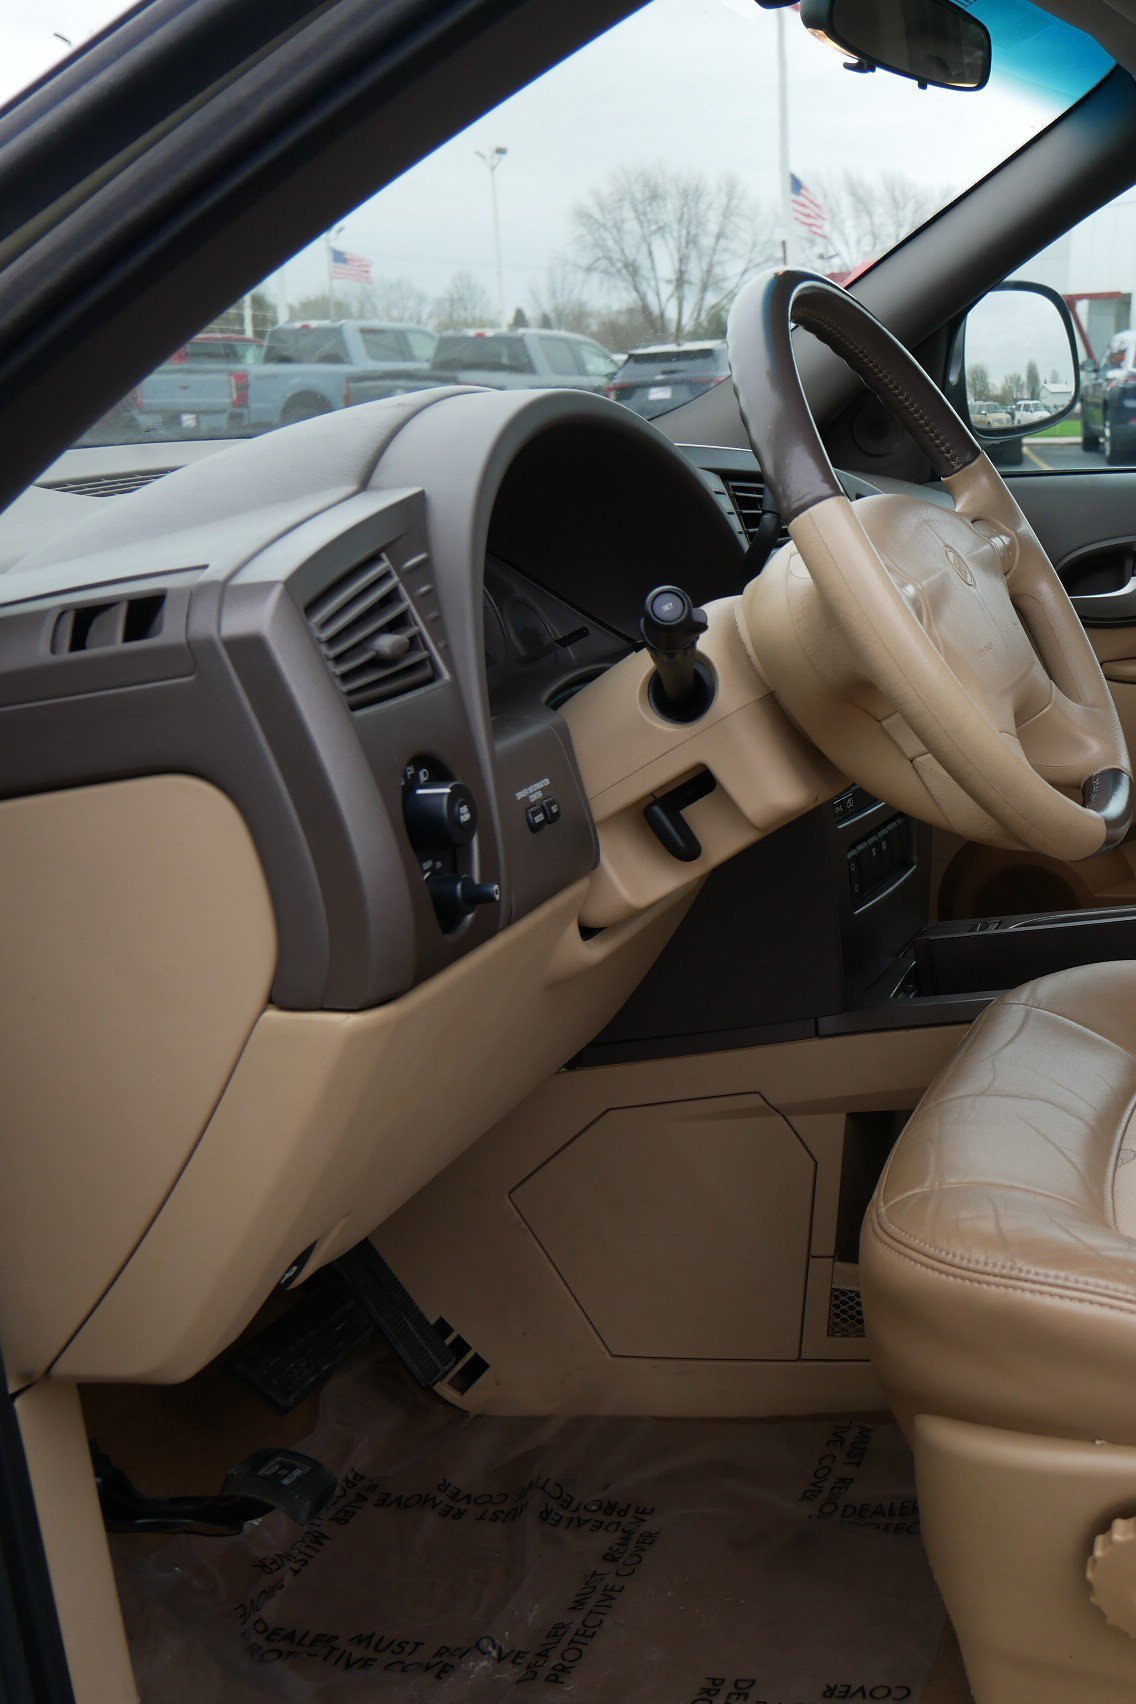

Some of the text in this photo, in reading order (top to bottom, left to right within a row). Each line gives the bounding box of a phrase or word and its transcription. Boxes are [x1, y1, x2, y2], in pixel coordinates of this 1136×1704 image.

[373, 1490, 468, 1521] REMOVE
[437, 1478, 509, 1507] COVER
[538, 1503, 622, 1533] DEALER
[545, 1529, 661, 1684] PROTECTIVE COVER
[348, 1630, 426, 1657] MUST
[516, 1620, 572, 1684] DEALER
[821, 1682, 912, 1701] COVER
